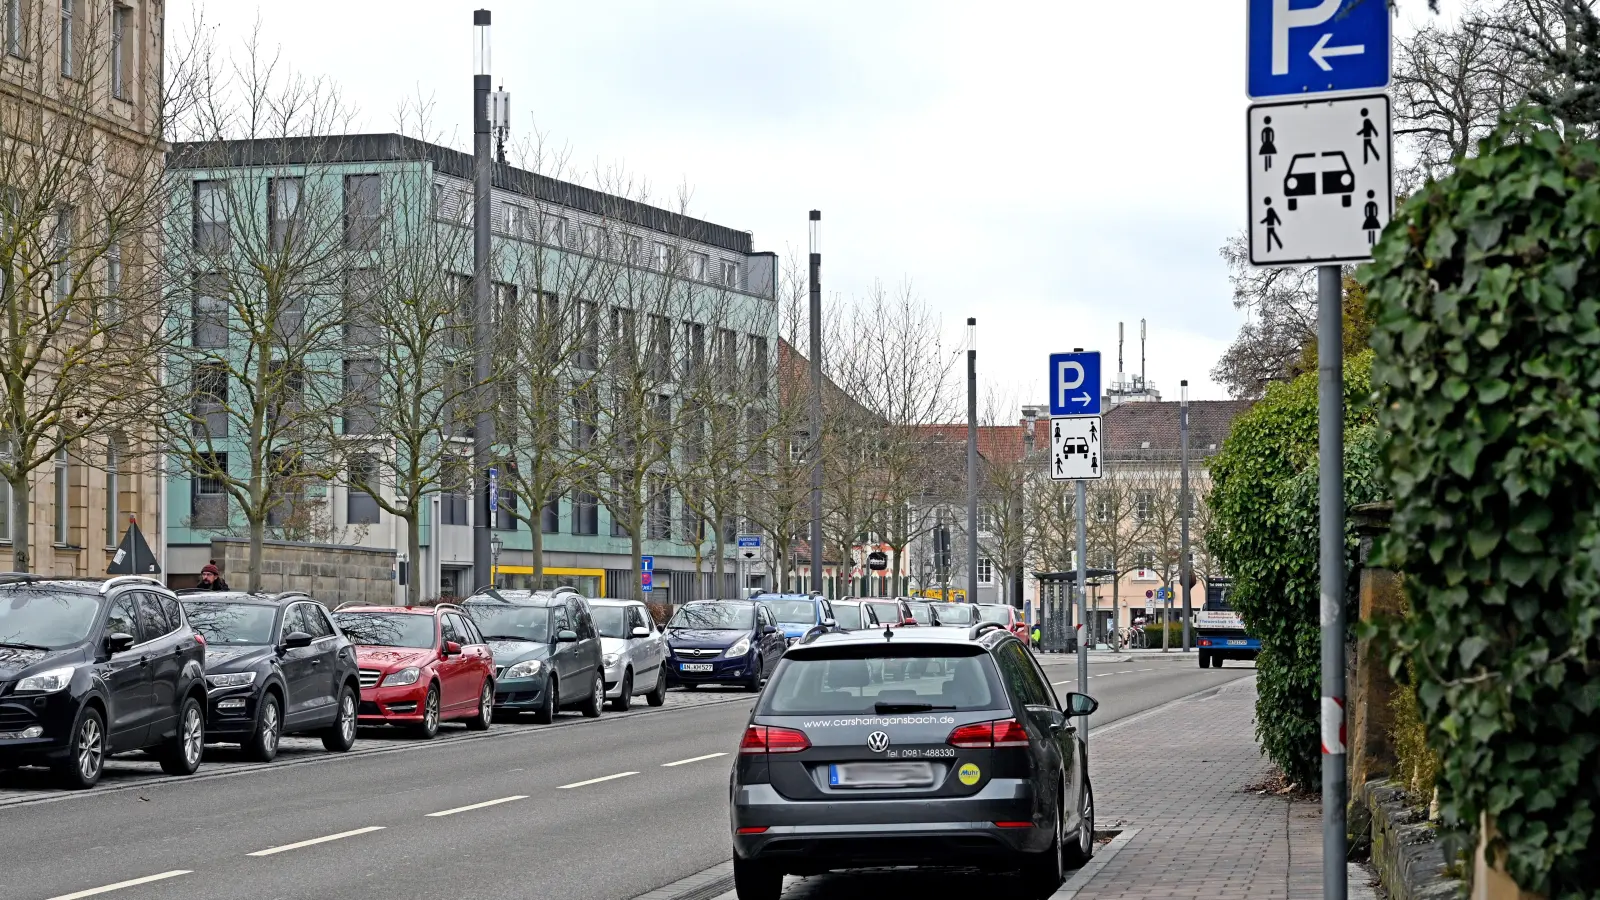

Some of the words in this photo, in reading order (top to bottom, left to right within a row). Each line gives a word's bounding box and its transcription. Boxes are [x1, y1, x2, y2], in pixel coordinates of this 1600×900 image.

[1272, 0, 1341, 76] P
[1058, 361, 1085, 408] P
[803, 716, 955, 728] www.carsharingansbach.de
[886, 750, 900, 758] Tel.
[902, 748, 955, 758] 0981-488330
